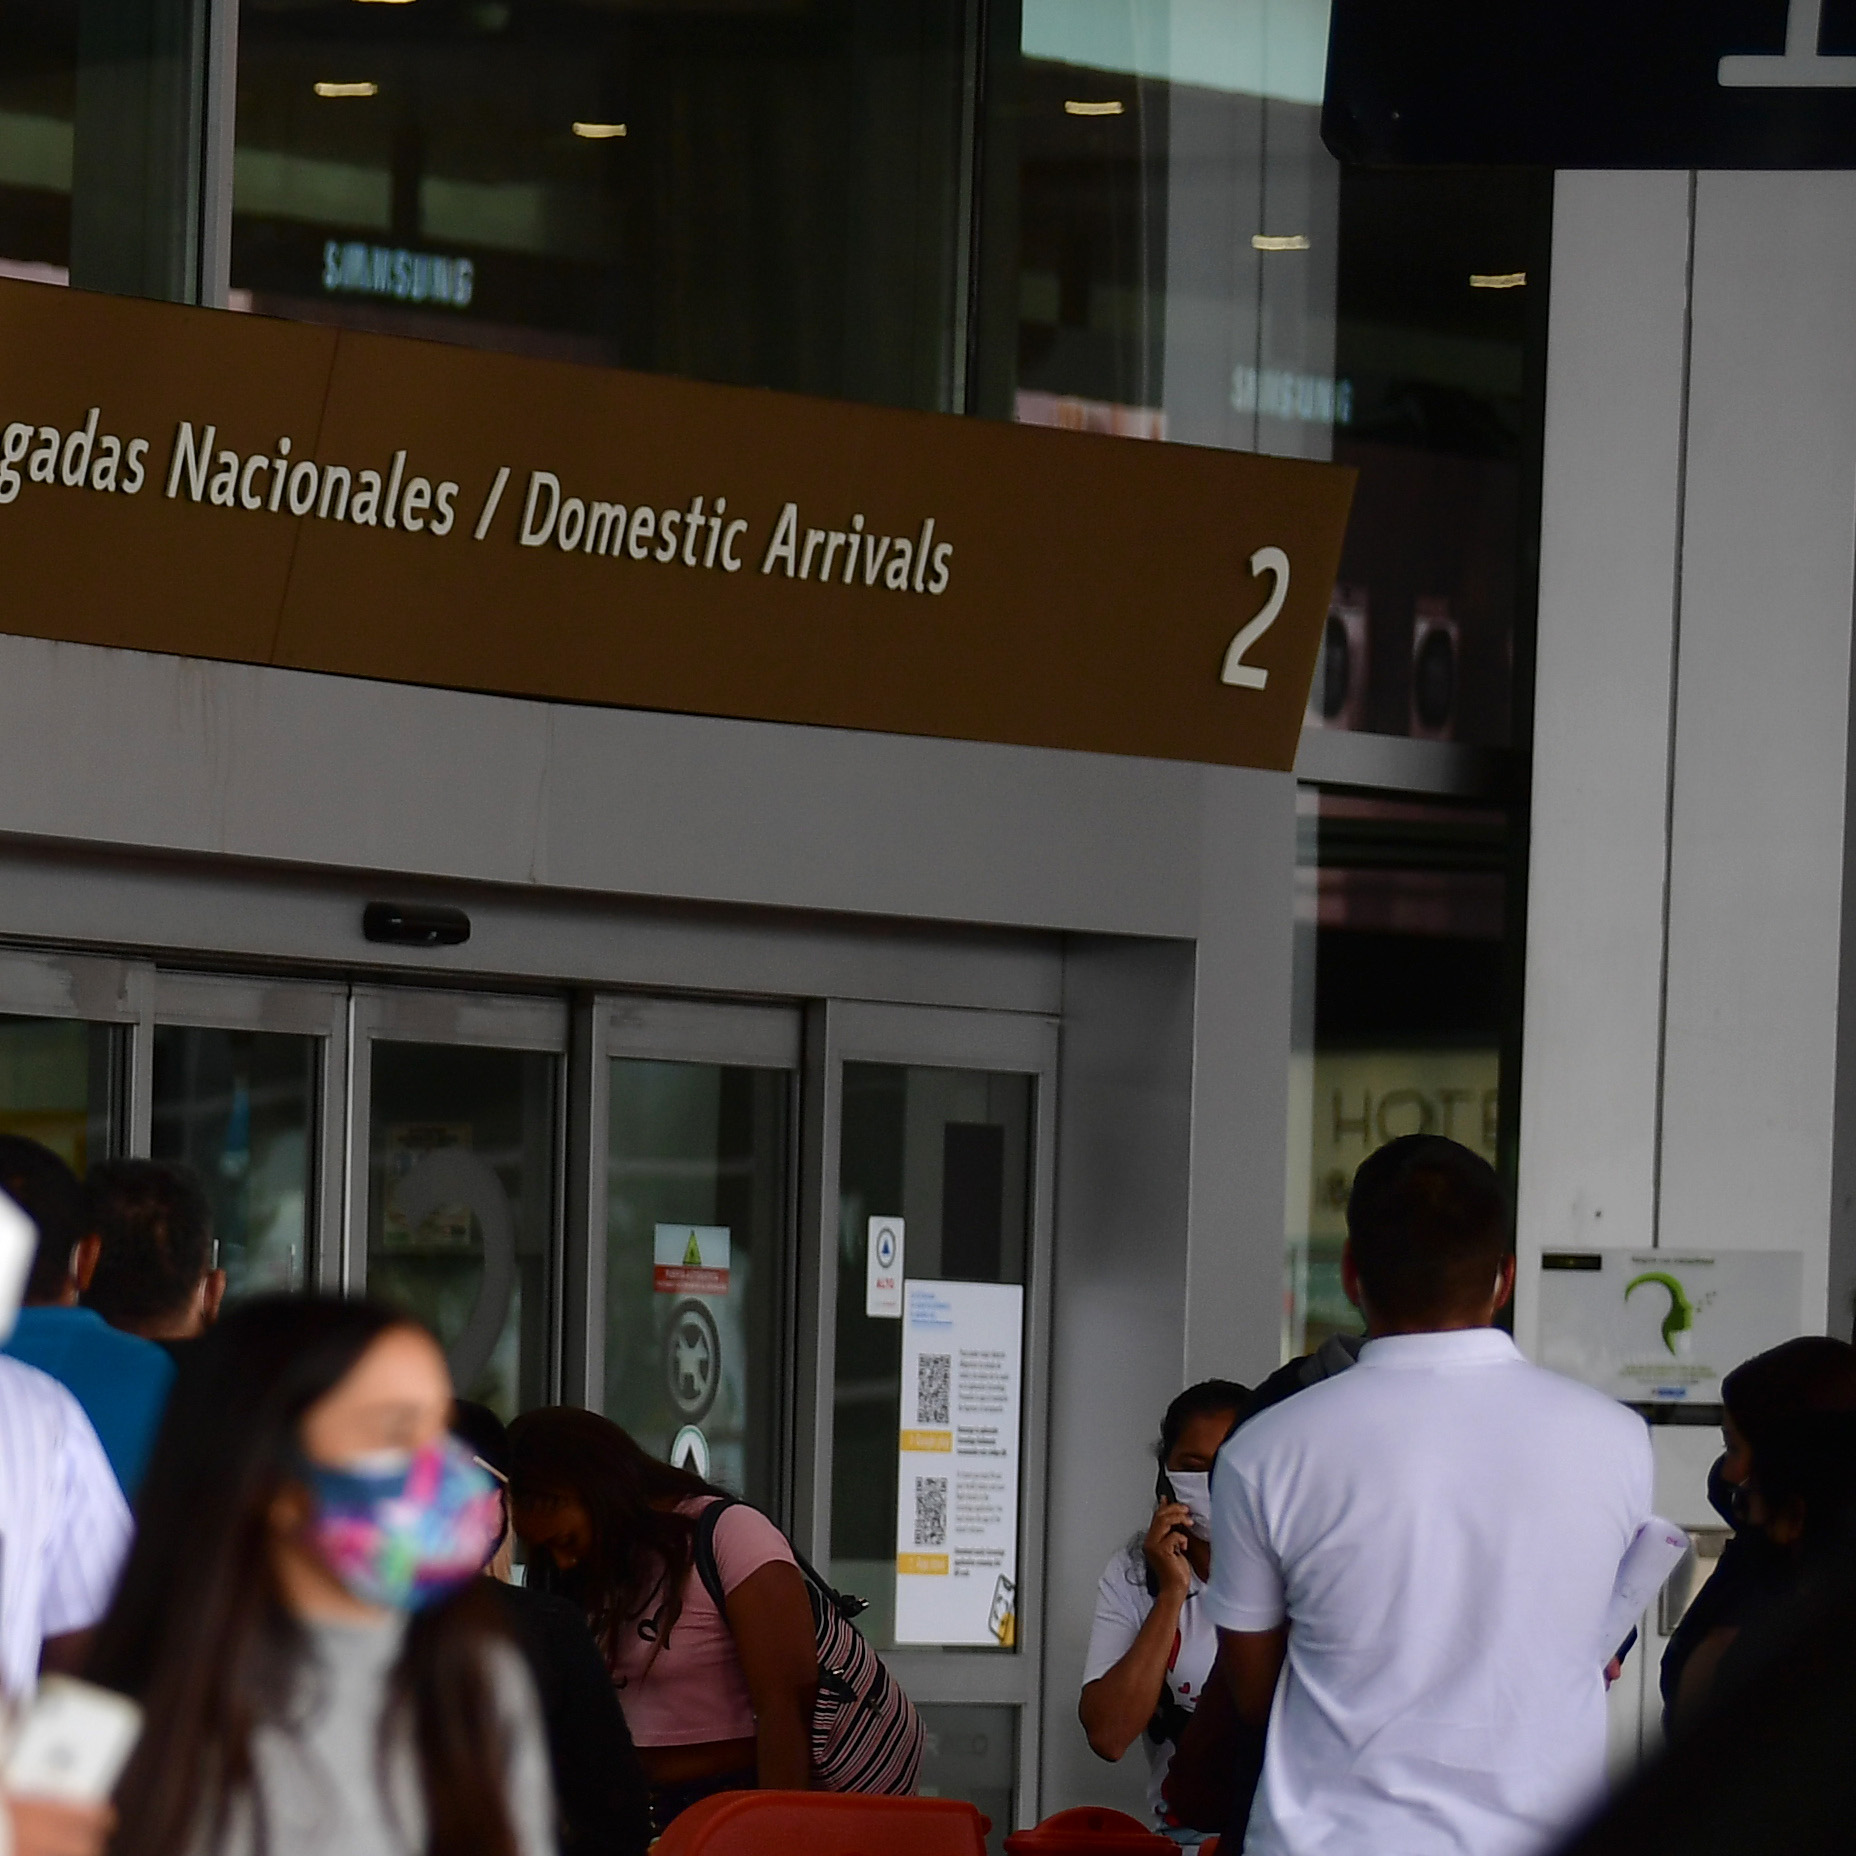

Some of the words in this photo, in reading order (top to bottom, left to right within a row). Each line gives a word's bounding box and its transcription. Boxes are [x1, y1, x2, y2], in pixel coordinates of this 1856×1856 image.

[323, 240, 474, 307] SAMSUNG
[164, 421, 460, 538] Nacionales
[472, 466, 511, 541] /
[520, 471, 748, 576] Domestic
[763, 502, 954, 597] Arrivals
[1221, 546, 1290, 691] 2
